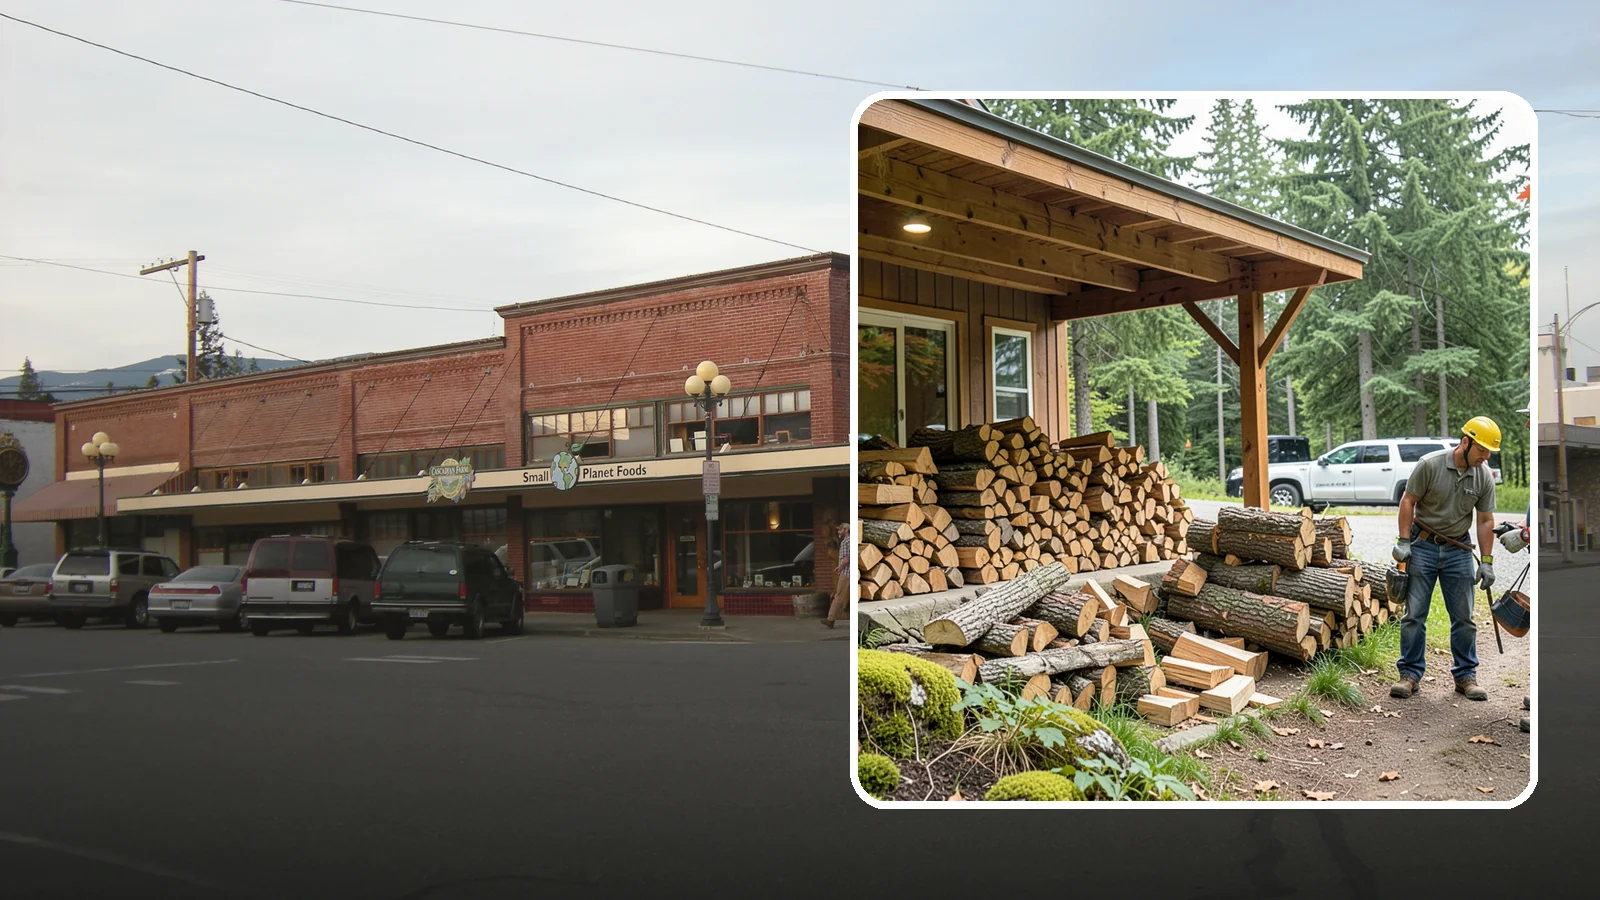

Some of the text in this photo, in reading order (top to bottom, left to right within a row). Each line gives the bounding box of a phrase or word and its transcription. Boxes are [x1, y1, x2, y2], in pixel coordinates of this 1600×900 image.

[523, 464, 647, 483] Small Planet Foods
